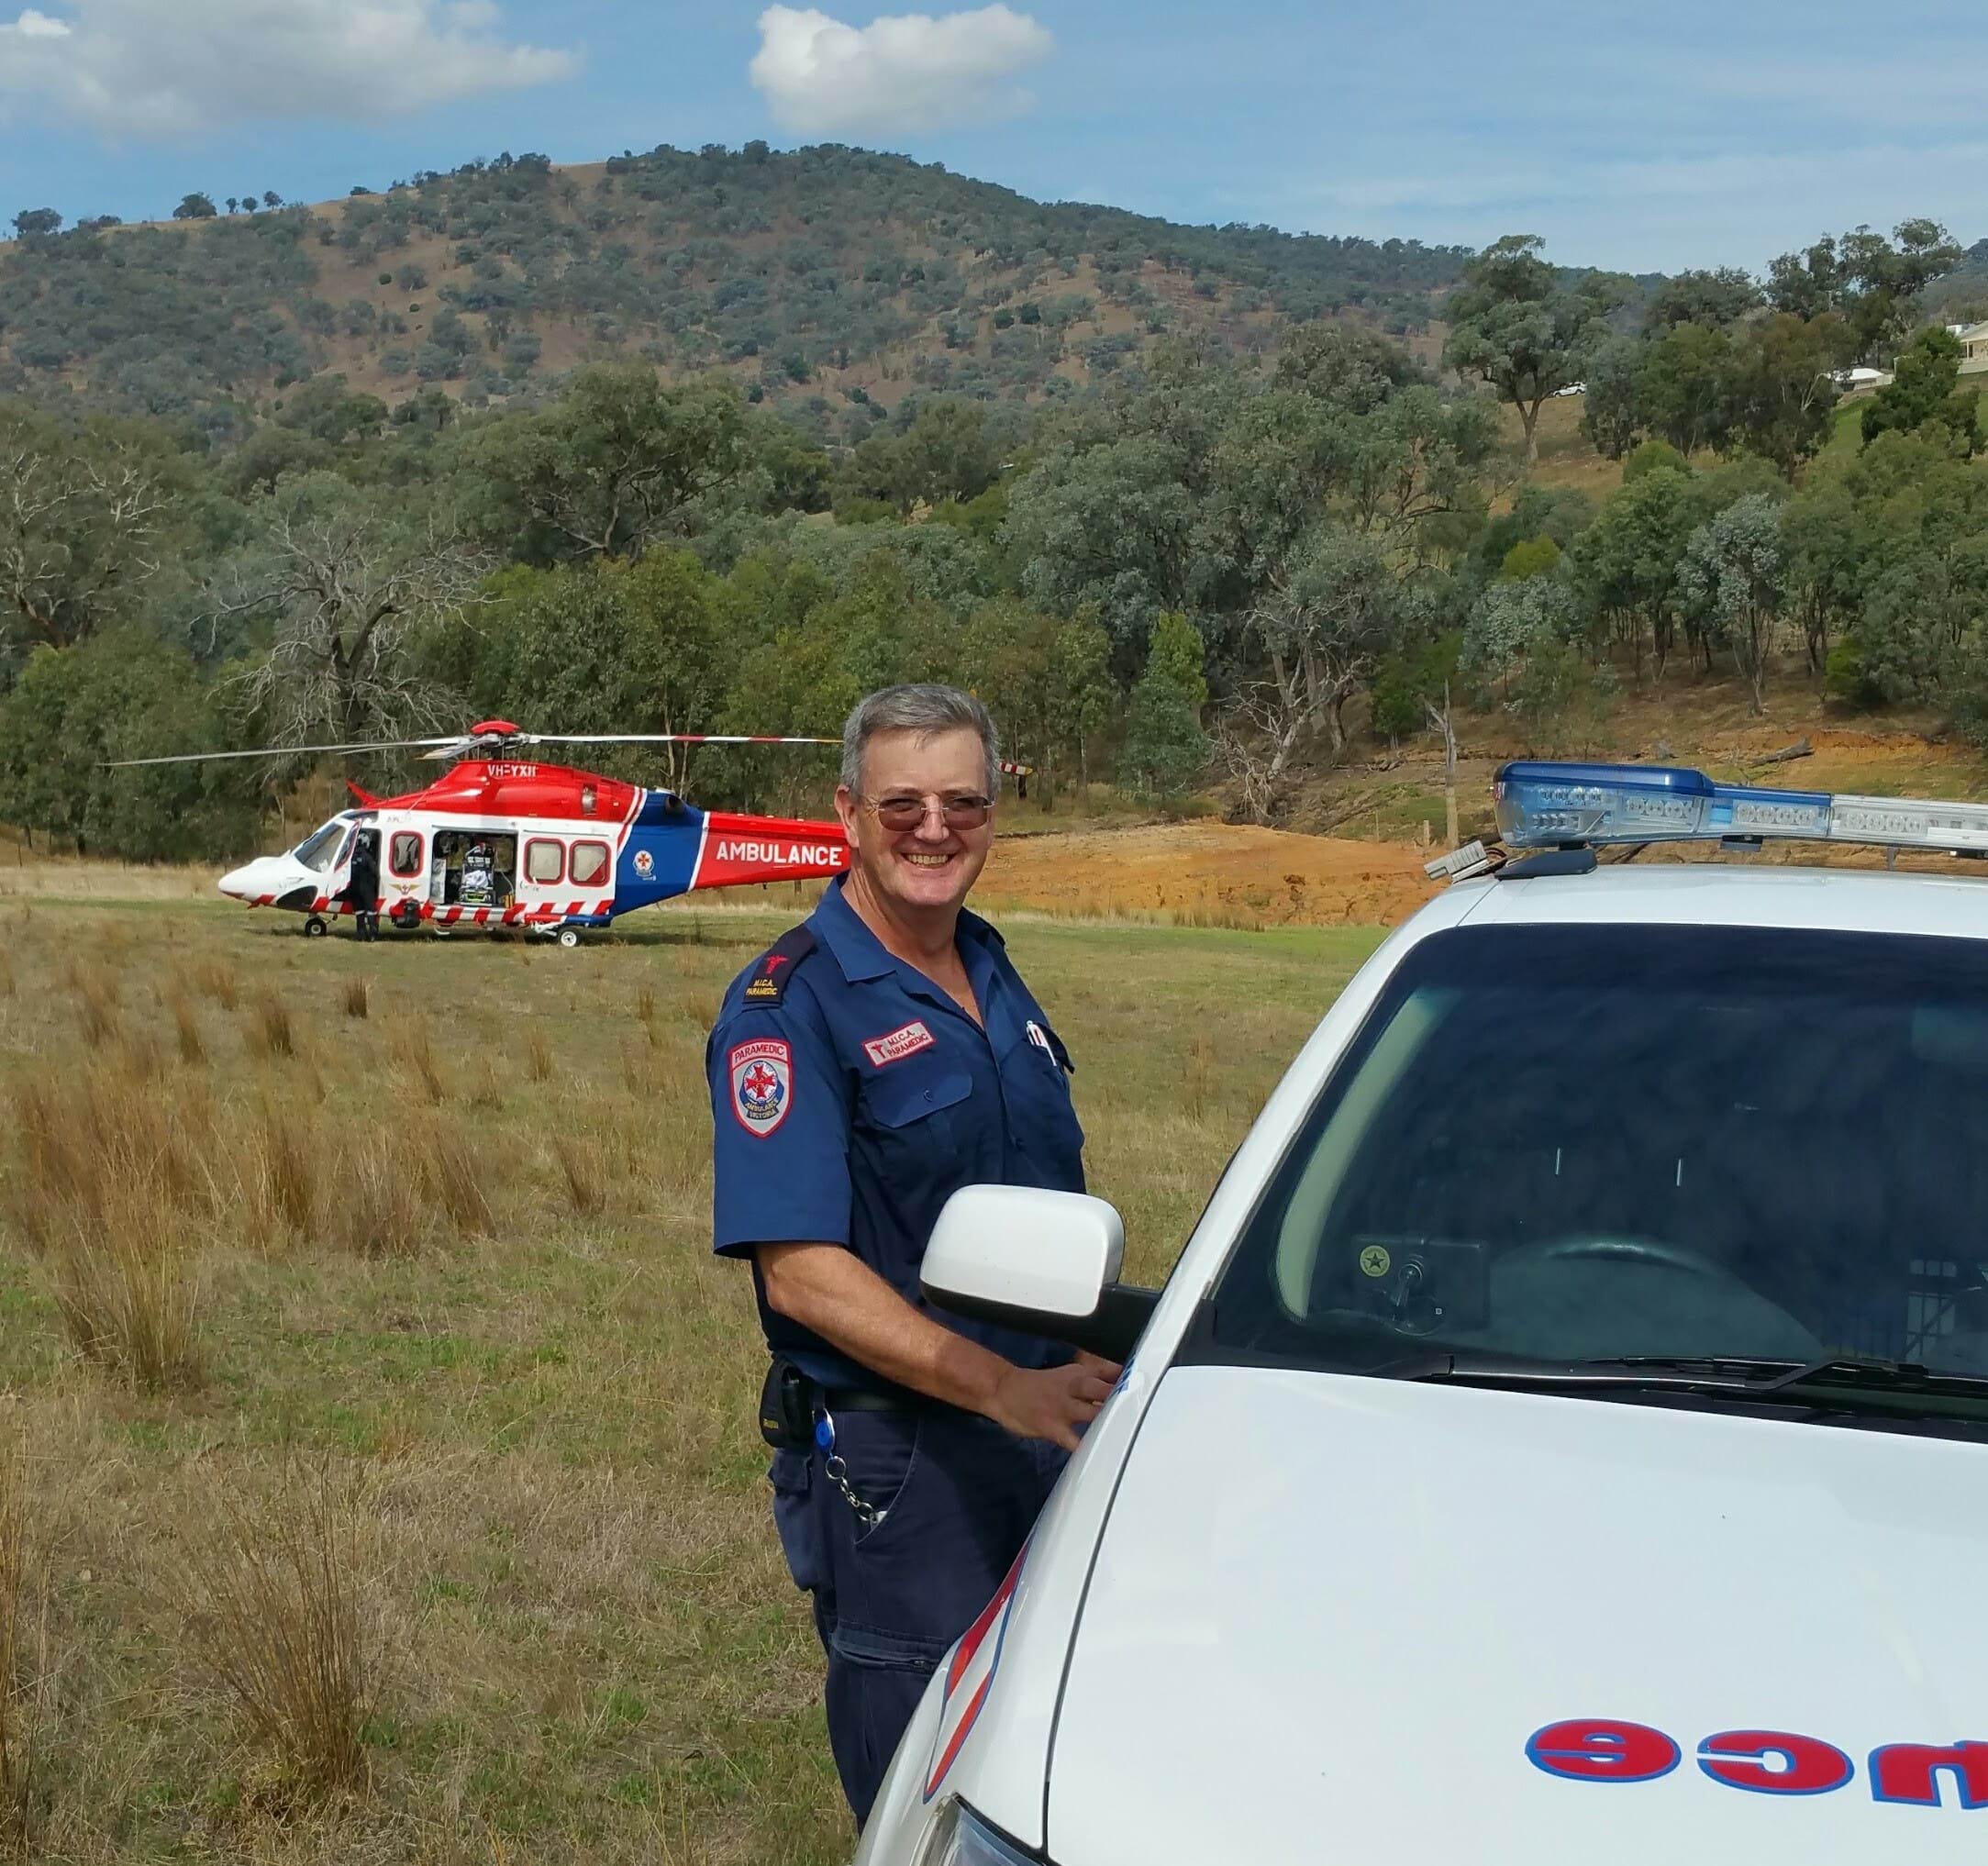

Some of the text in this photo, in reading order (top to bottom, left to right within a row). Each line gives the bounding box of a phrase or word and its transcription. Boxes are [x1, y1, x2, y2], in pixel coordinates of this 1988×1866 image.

[716, 841, 843, 866] AMBULANCE
[745, 987, 778, 995] PARAMEDIC
[734, 1044, 784, 1063] PARAMEDIC
[887, 1033, 928, 1057] PARAMEDIC
